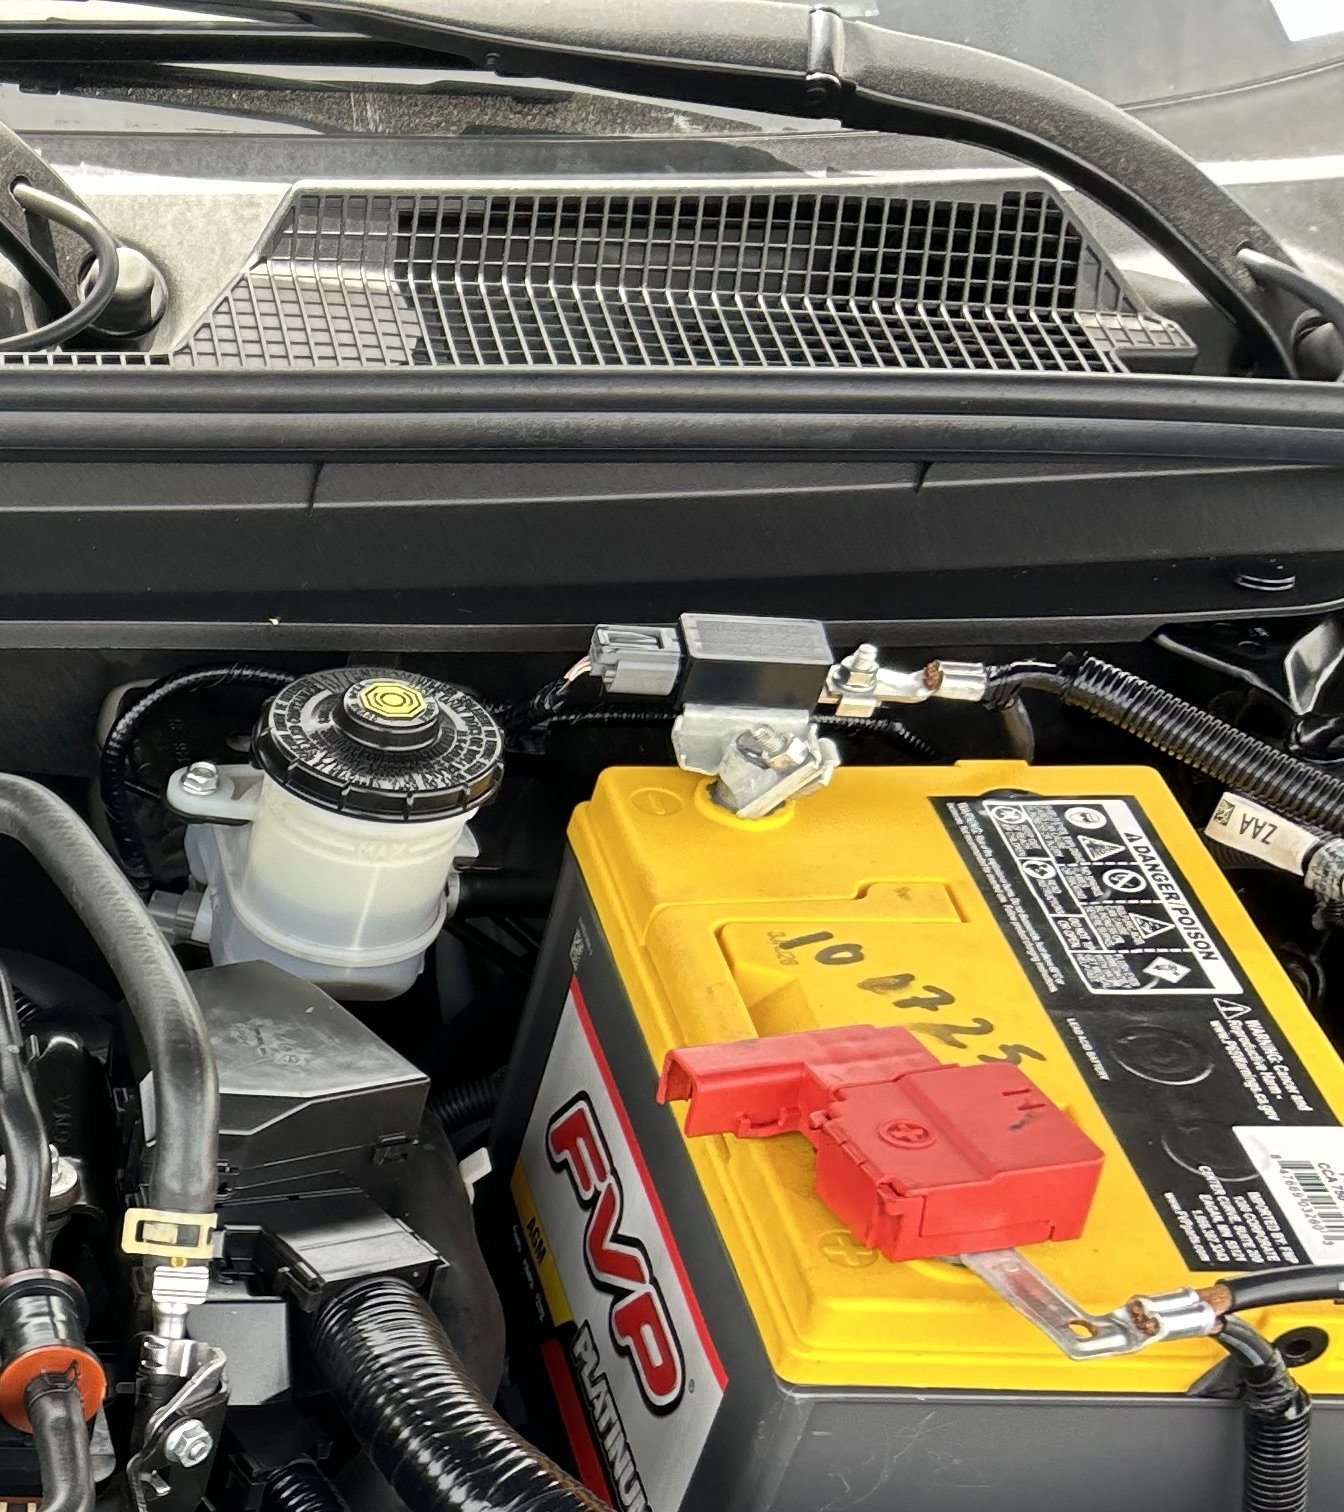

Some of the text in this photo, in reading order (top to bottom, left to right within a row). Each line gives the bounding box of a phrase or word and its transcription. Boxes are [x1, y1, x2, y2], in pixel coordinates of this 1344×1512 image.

[1240, 813, 1278, 845] ZAA
[1132, 845, 1220, 960] DANGER/POISON
[779, 931, 863, 965] 10
[525, 1216, 546, 1265] AGM
[548, 1100, 682, 1408] FVP
